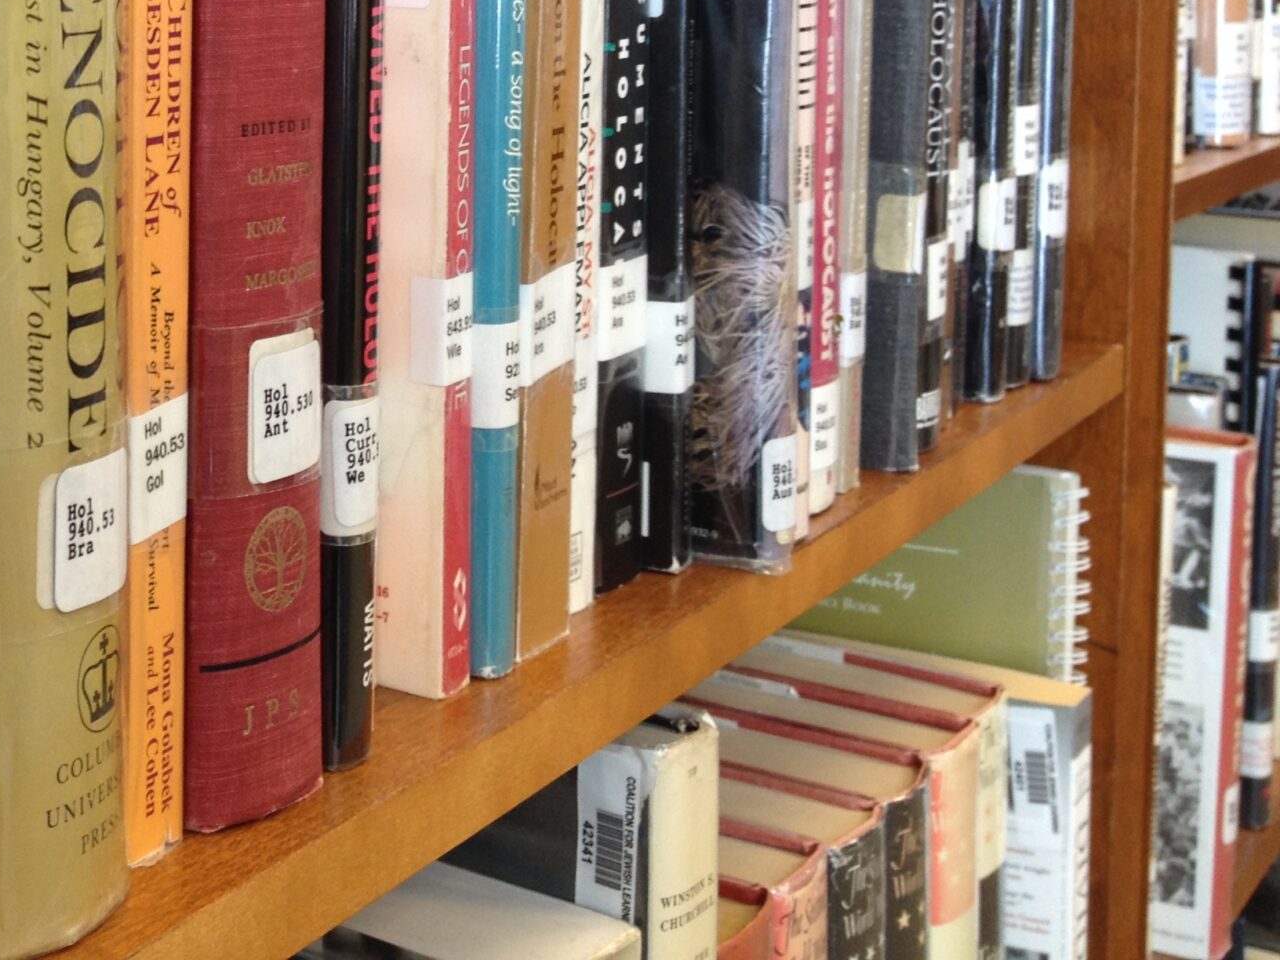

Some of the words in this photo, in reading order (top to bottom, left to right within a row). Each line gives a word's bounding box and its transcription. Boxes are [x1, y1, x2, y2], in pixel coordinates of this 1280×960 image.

[23, 41, 49, 77] in
[511, 50, 524, 67] a
[551, 54, 567, 112] the
[455, 44, 472, 193] LEGENDS
[504, 75, 523, 127] song
[579, 52, 593, 154] ALICIA
[240, 119, 296, 139] EDITED
[503, 137, 524, 157] of
[16, 93, 50, 265] Hungary,
[143, 134, 165, 239] LANE
[164, 187, 183, 219] of
[455, 198, 470, 241] OF
[245, 215, 286, 240] KNOX
[150, 263, 161, 277] A
[583, 240, 594, 290] MY
[149, 287, 161, 353] Memoir
[25, 283, 51, 413] Volume
[162, 312, 175, 370] Beyond
[148, 360, 161, 379] of
[263, 382, 289, 404] Hol
[25, 431, 44, 450] 2
[144, 416, 162, 440] Hol
[263, 418, 289, 439] Ant
[344, 416, 371, 437] Hol
[144, 433, 186, 467] 940.53
[146, 469, 164, 493] Gol
[345, 470, 366, 486] We
[67, 497, 94, 522] Hol
[68, 508, 115, 541] 940.53
[67, 540, 95, 561] Bra
[146, 645, 159, 680] and
[161, 632, 176, 704] Mona
[145, 687, 160, 732] Lee
[144, 737, 159, 819] Cohen
[160, 711, 176, 814] Golabek
[625, 775, 637, 825] COALITION
[580, 820, 595, 866] 42341
[624, 826, 635, 846] FOR
[622, 848, 634, 885] JEWISH
